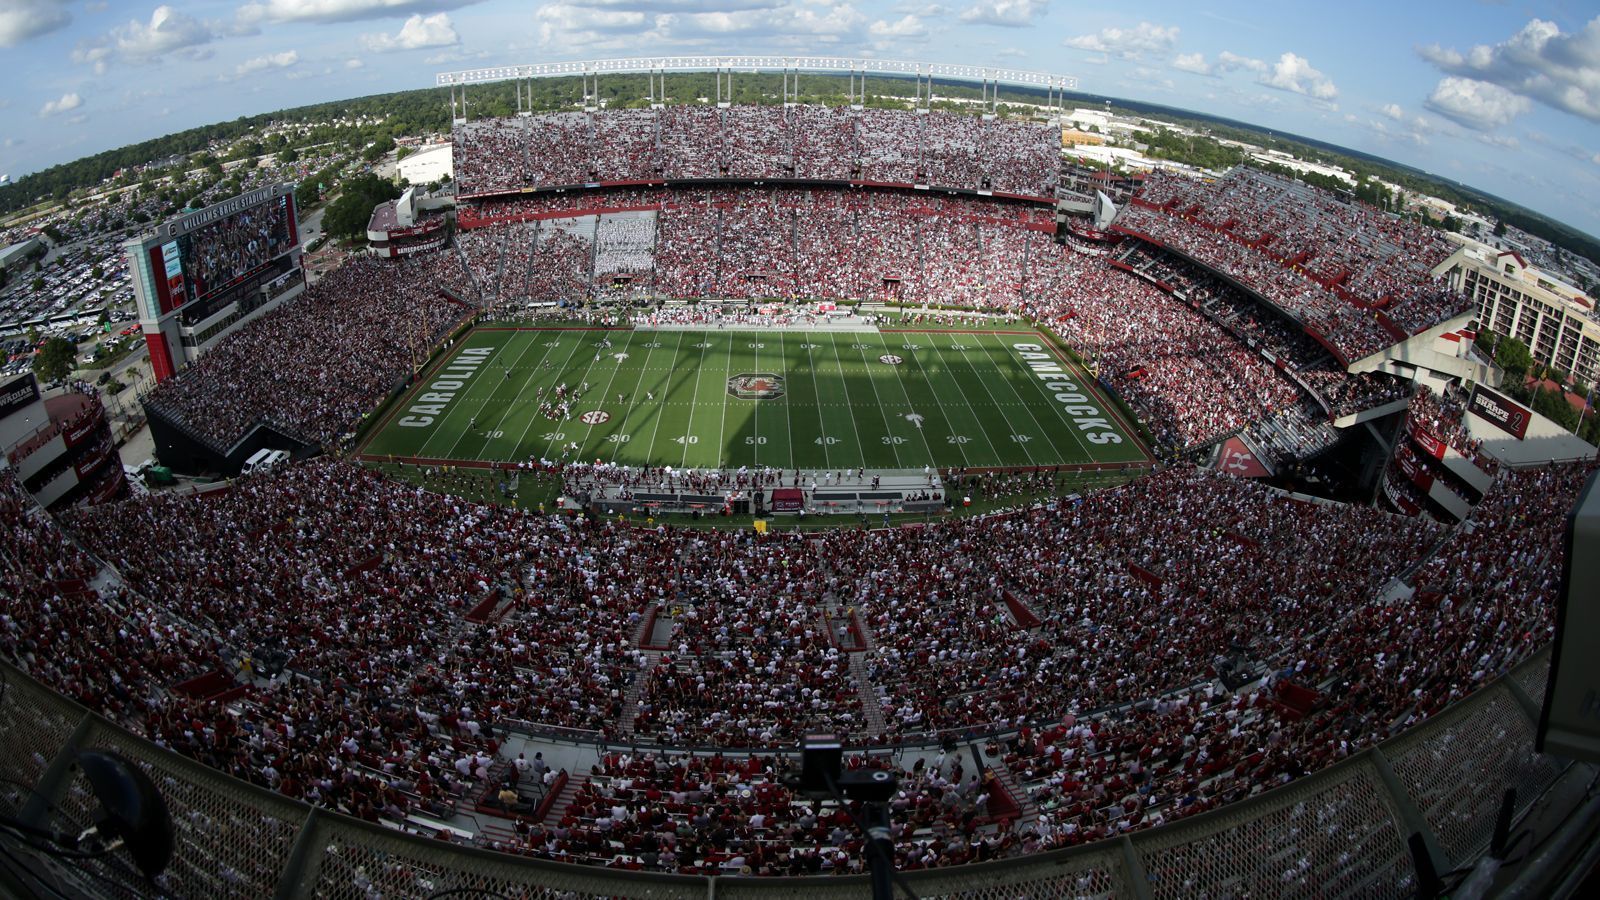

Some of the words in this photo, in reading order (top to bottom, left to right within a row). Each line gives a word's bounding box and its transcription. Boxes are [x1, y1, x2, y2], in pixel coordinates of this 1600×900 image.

[240, 189, 268, 208] STADIUM
[880, 355, 903, 365] SEC
[398, 347, 495, 428] CAROLINA
[1013, 343, 1122, 444] GAMECOCKS
[1475, 396, 1510, 419] SHARPE
[583, 411, 609, 424] SEC
[1510, 411, 1524, 432] 2
[485, 431, 504, 439] 10
[543, 433, 566, 441] 20
[608, 434, 631, 443] 30
[676, 435, 699, 444] 40
[946, 435, 968, 444] 20
[1010, 434, 1029, 443] 10
[745, 436, 767, 445] 50
[814, 436, 836, 445] 40
[881, 436, 903, 445] 30
